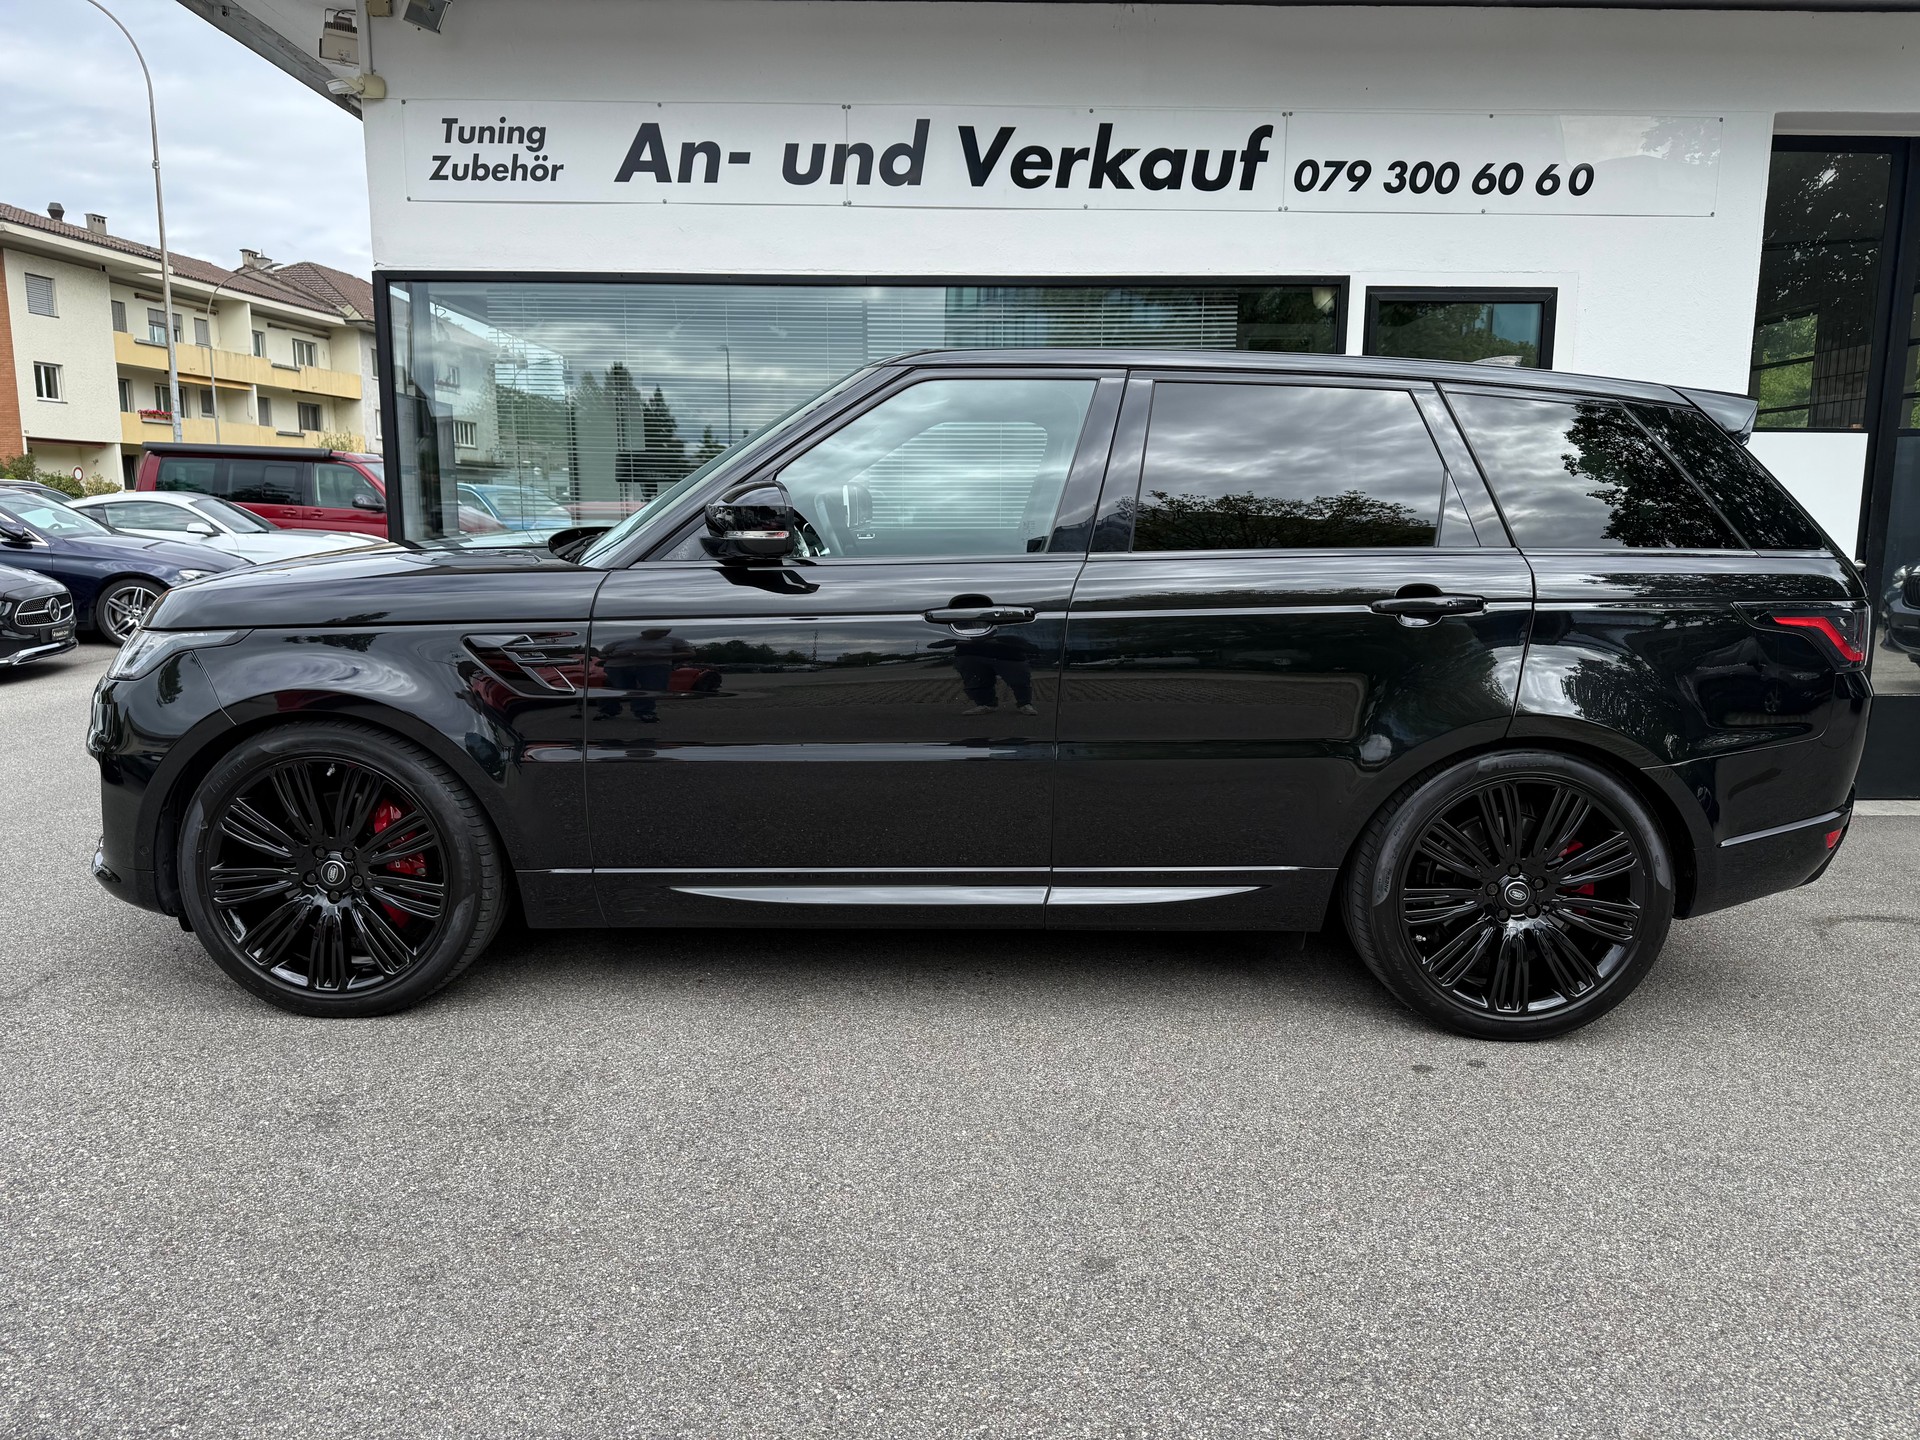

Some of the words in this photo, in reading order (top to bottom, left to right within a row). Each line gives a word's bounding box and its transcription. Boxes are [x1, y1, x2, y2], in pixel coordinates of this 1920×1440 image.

[441, 117, 546, 153] Tuning
[428, 154, 565, 182] Zubehör
[613, 122, 751, 184] An-
[782, 118, 931, 187] und
[957, 124, 1275, 192] Verkauf
[1293, 159, 1372, 193] 079
[1383, 160, 1460, 195] 300
[1471, 162, 1524, 196] 60
[1535, 163, 1595, 197] 60
